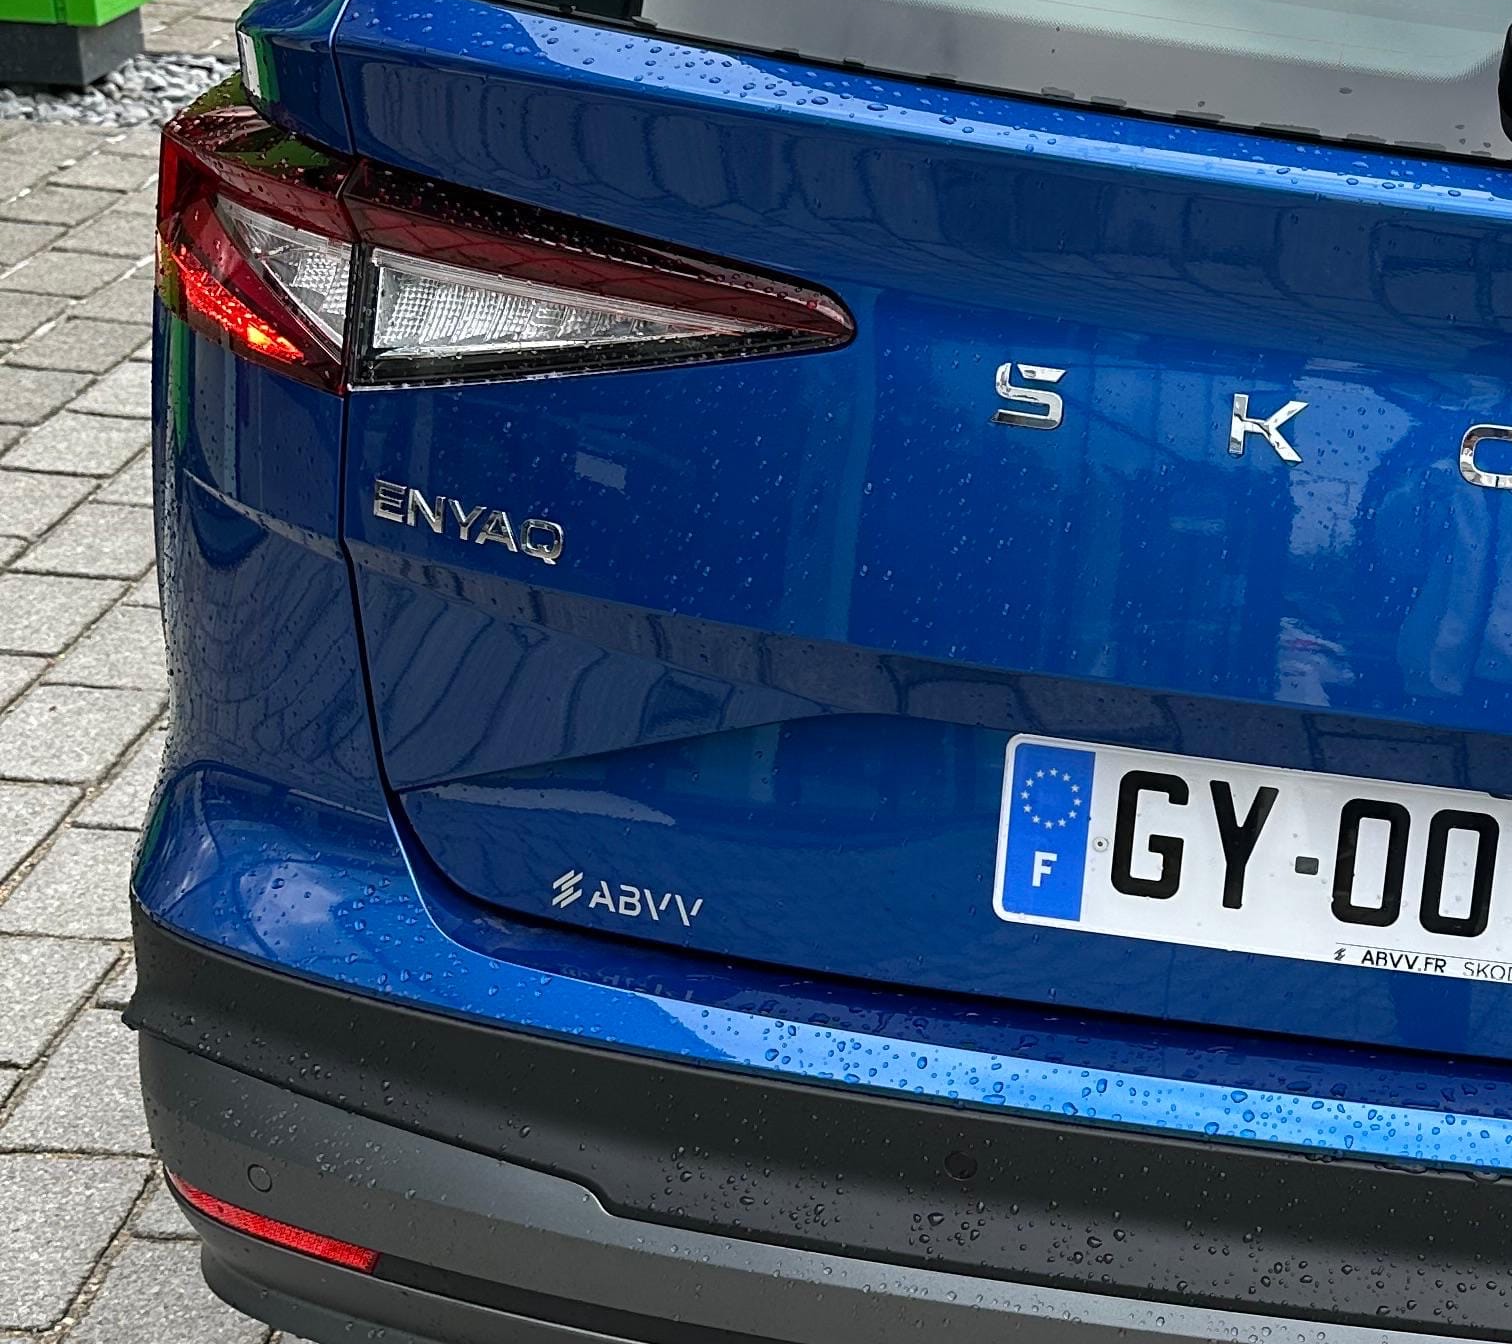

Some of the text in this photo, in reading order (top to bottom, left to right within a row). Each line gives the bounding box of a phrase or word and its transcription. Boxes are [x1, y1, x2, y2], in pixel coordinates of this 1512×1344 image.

[373, 478, 564, 565] ENYAQ
[1032, 851, 1058, 888] F
[588, 880, 704, 927] ABVV
[1361, 949, 1447, 973] ABVV.FR
